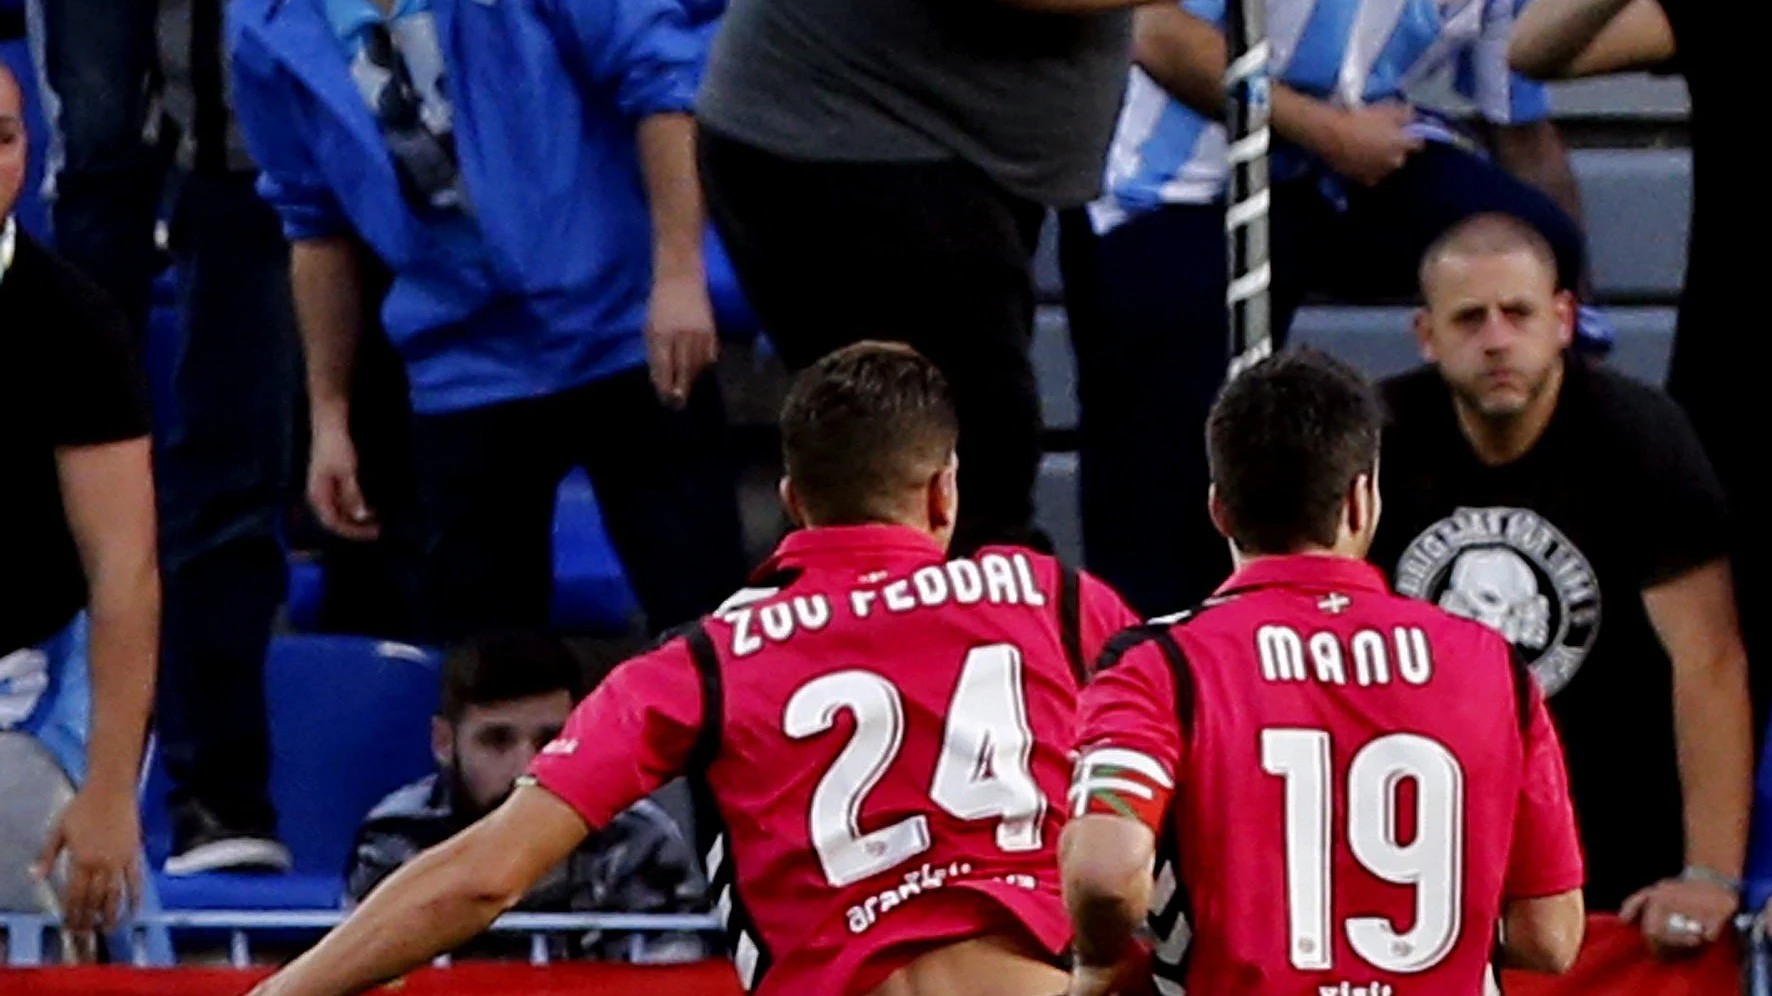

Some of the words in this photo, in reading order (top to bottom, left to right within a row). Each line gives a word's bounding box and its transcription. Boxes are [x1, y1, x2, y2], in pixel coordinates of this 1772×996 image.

[851, 553, 1044, 617] FEDDAL
[1256, 625, 1435, 687] MANU
[783, 644, 1046, 887] 24
[1259, 727, 1466, 976] 19
